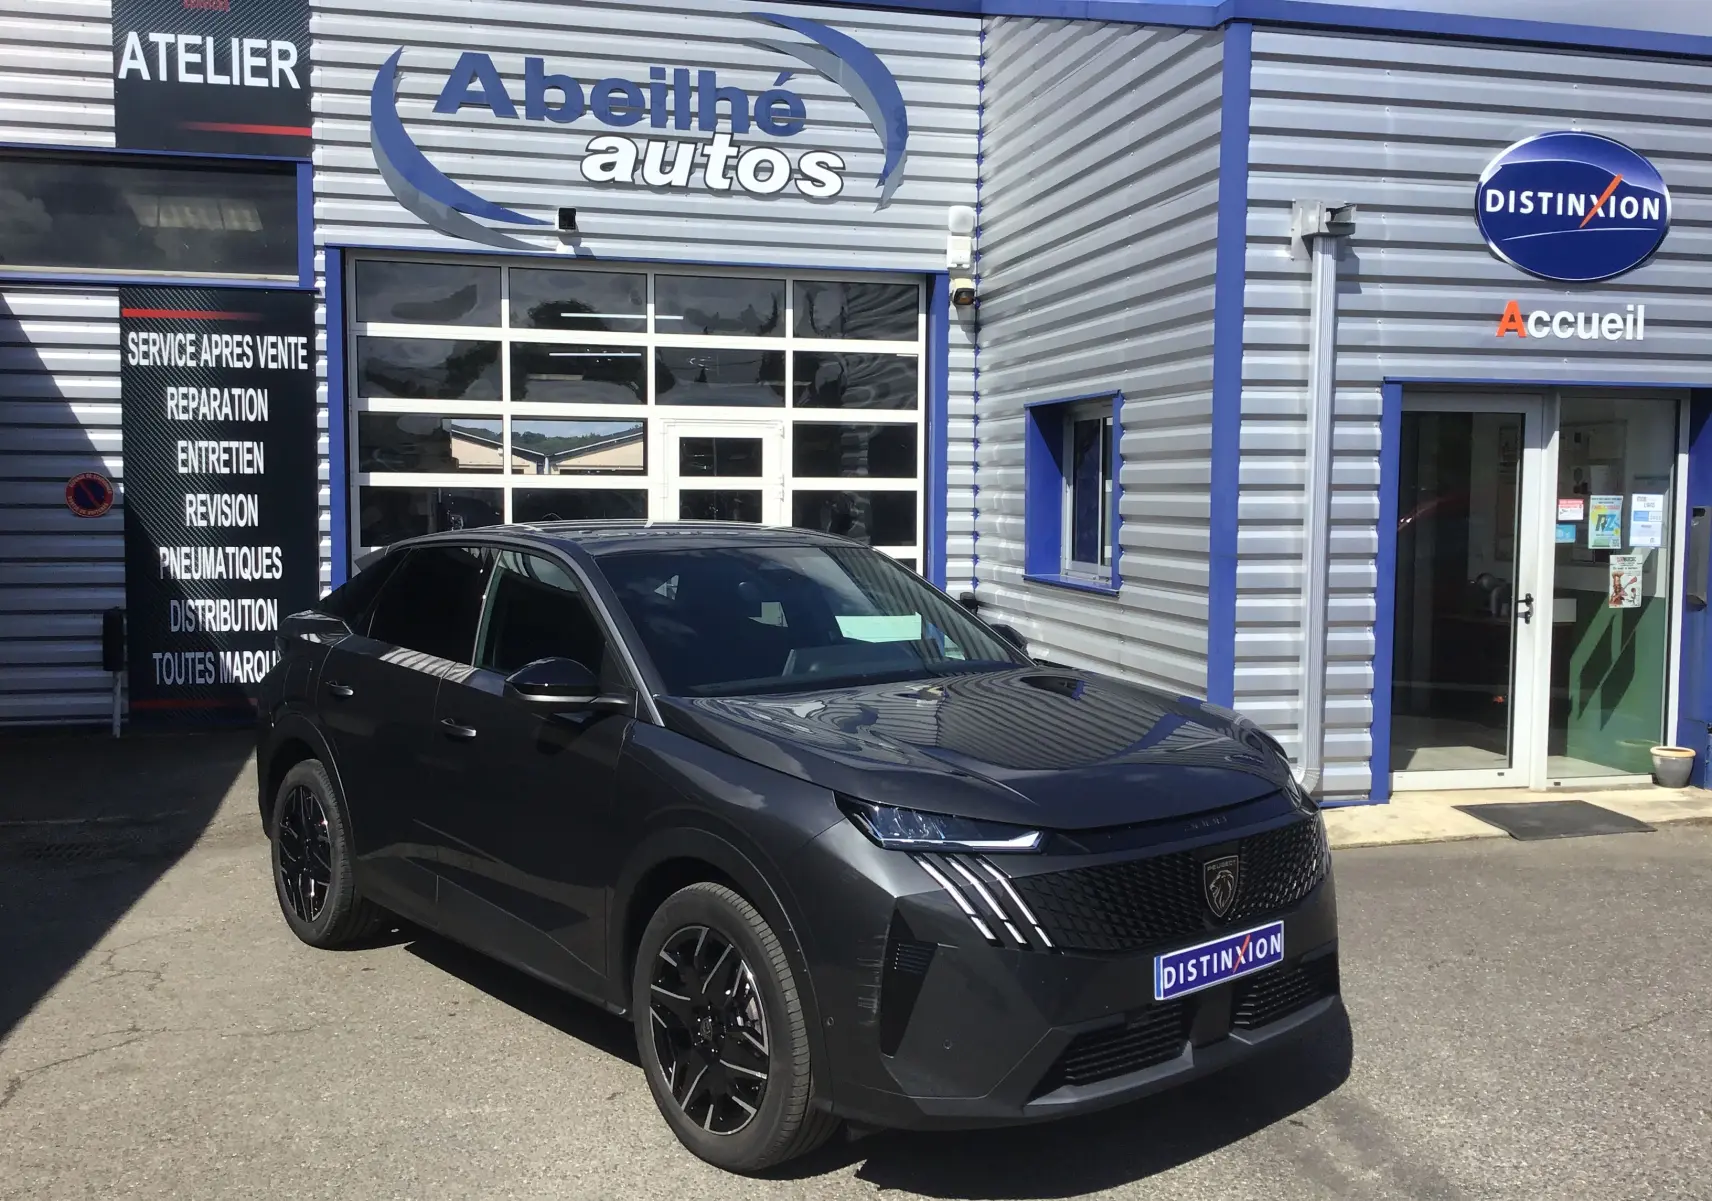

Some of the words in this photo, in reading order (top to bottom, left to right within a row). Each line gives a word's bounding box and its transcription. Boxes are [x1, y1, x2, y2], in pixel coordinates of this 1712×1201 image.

[117, 31, 301, 89] ATELIER
[432, 52, 807, 137] Abeilhé
[580, 132, 847, 198] autos
[1485, 176, 1660, 226] DISTINXION
[1495, 300, 1645, 341] Accueil
[127, 331, 197, 367] SERVICE
[200, 333, 254, 369] APRES
[256, 335, 308, 370] VENTE
[166, 386, 269, 422] REPARATION
[177, 440, 265, 475] ENTRETIEN
[185, 493, 259, 527] REVISION
[159, 545, 283, 582] PNEUMATIQUES
[170, 598, 278, 633] DISTRIBUTION
[152, 651, 216, 685] TOUTES
[219, 650, 281, 684] MARQU
[1163, 932, 1281, 990] DISTINXION
